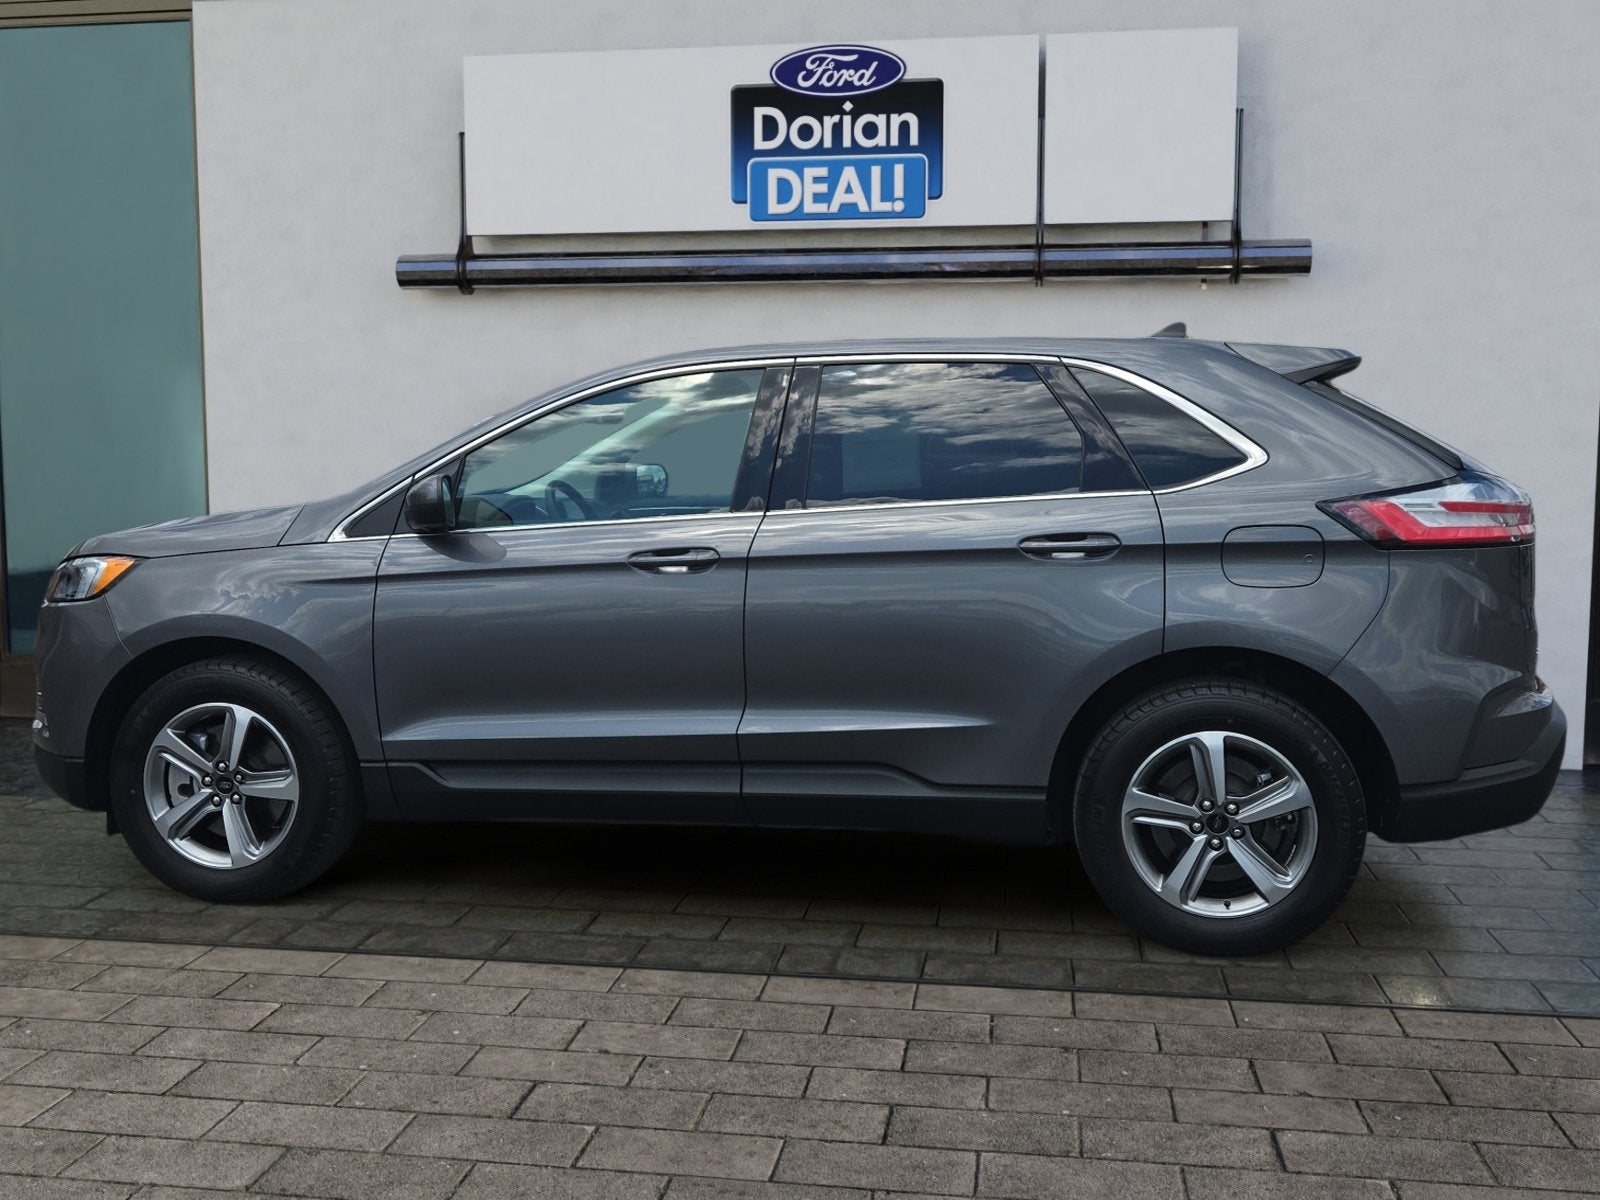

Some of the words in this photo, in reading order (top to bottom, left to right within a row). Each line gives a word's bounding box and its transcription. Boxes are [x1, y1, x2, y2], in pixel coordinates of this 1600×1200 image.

[797, 53, 879, 88] Ford
[753, 100, 919, 150] Dorian
[767, 163, 905, 215] DEAL!
